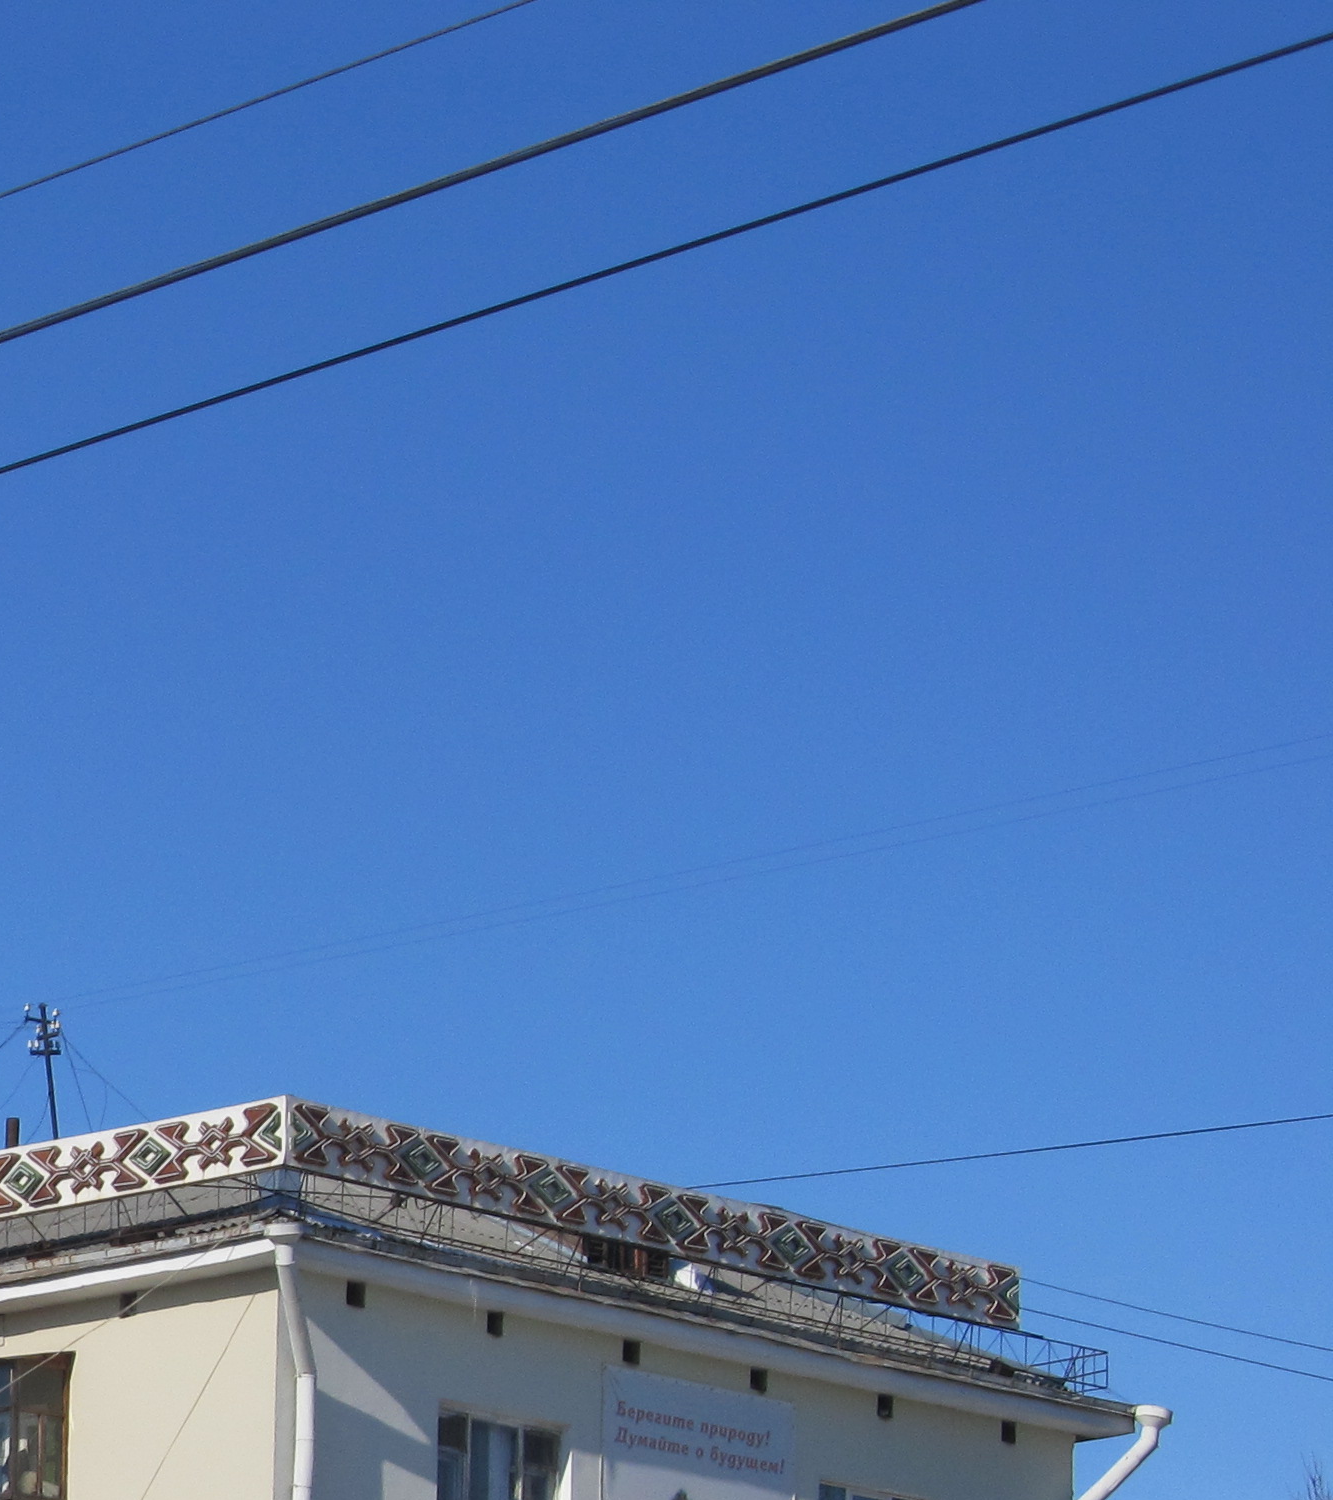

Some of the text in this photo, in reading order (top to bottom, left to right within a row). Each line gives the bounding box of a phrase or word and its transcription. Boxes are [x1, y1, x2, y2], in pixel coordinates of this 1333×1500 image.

[616, 1400, 771, 1448] Берегите природу!
[615, 1426, 785, 1475] Думайте о будущем!
